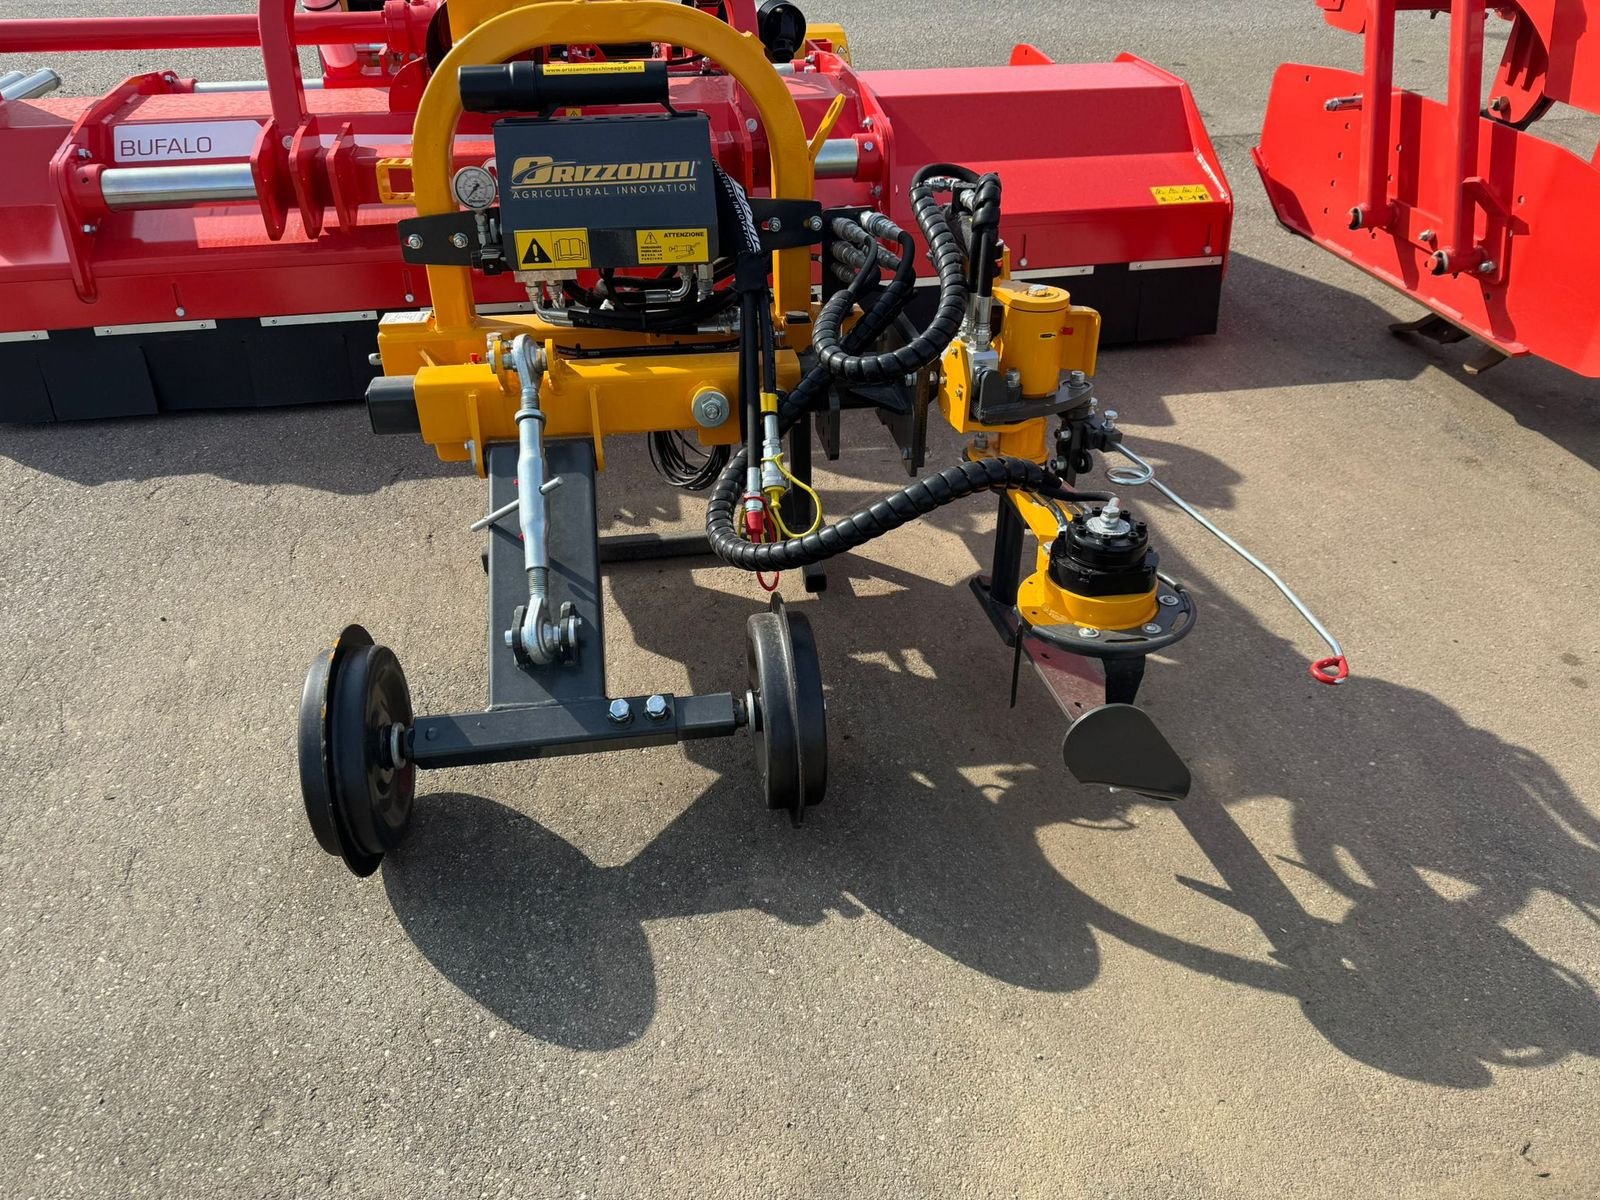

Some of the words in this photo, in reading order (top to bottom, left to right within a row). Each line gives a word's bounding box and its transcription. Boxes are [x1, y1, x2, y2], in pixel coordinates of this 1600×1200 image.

[120, 136, 212, 156] BUFALO
[511, 155, 691, 185] ORIZZONTI
[512, 187, 609, 200] AGRICULTURAL
[616, 183, 697, 195] INNOVATION
